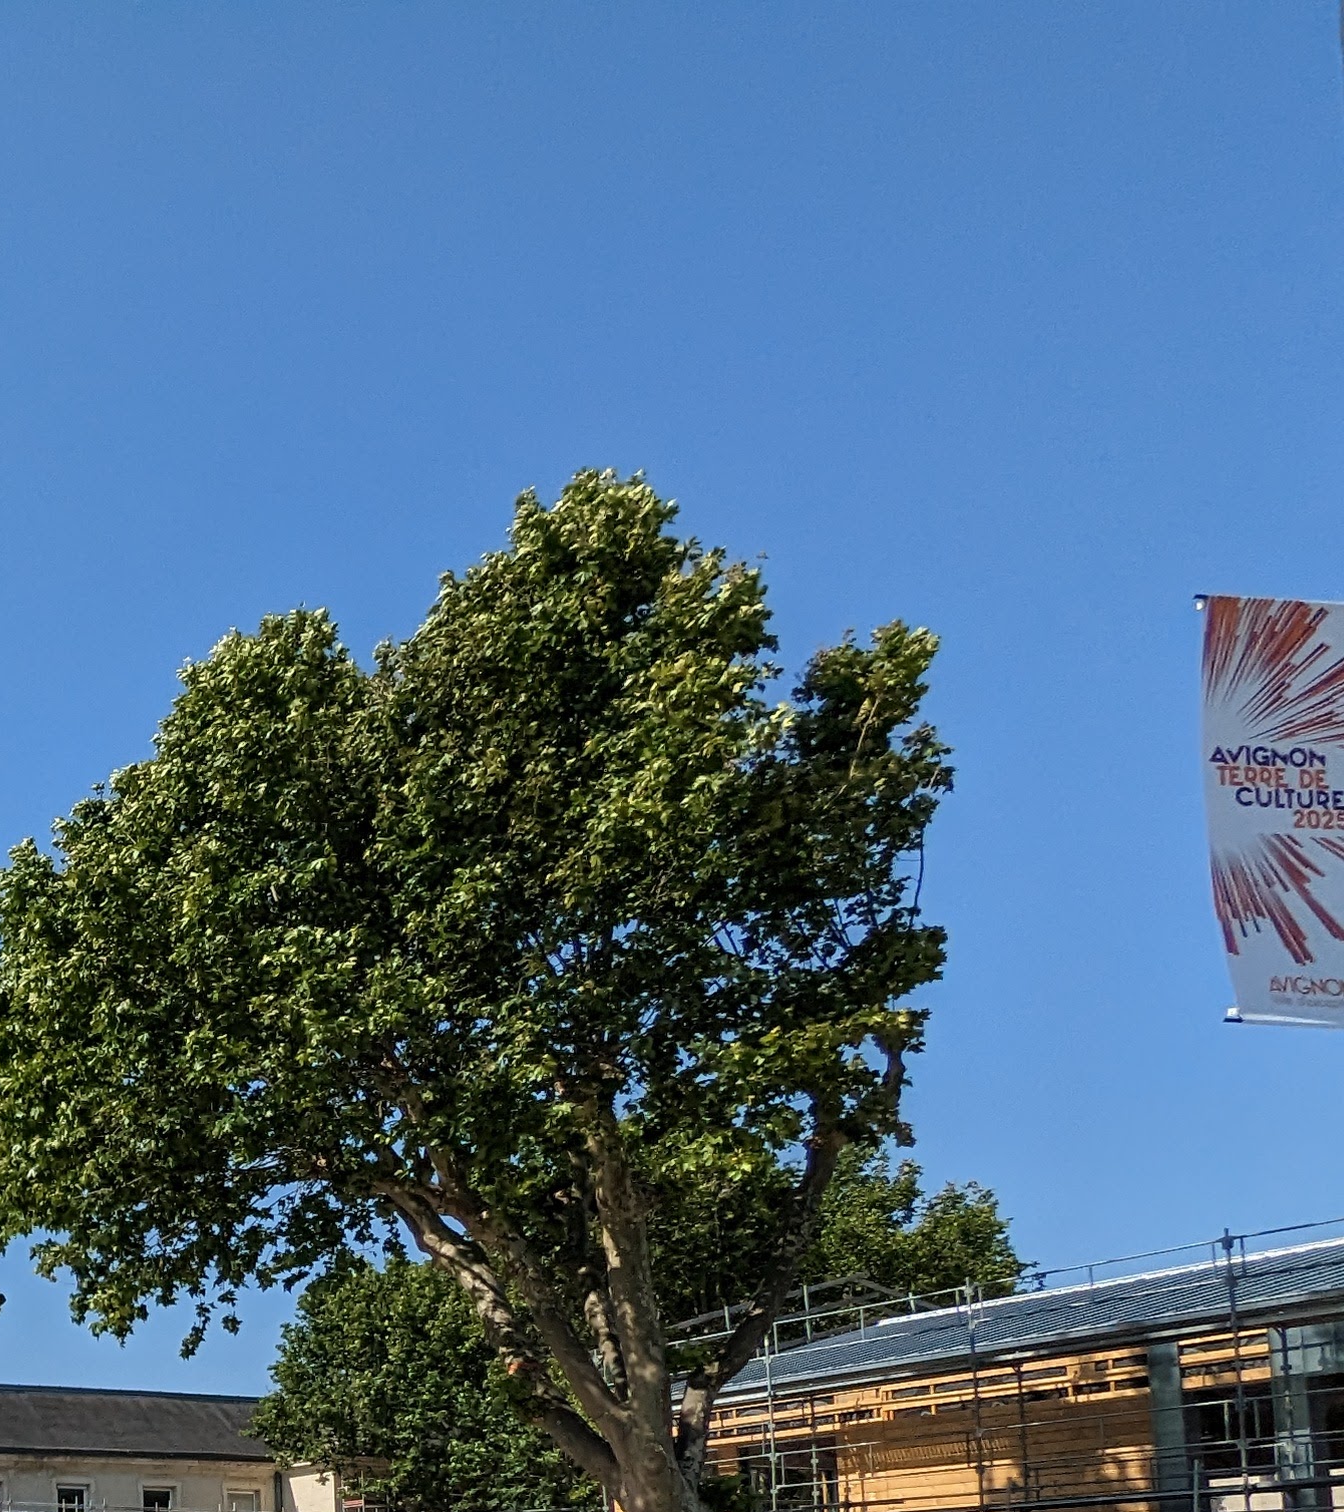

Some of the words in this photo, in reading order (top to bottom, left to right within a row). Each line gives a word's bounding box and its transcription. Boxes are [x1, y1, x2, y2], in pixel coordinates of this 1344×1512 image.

[1208, 745, 1326, 768] AVIGNON
[1217, 766, 1288, 788] TERRE
[1299, 768, 1329, 789] DE
[1235, 786, 1344, 811] CULTURE
